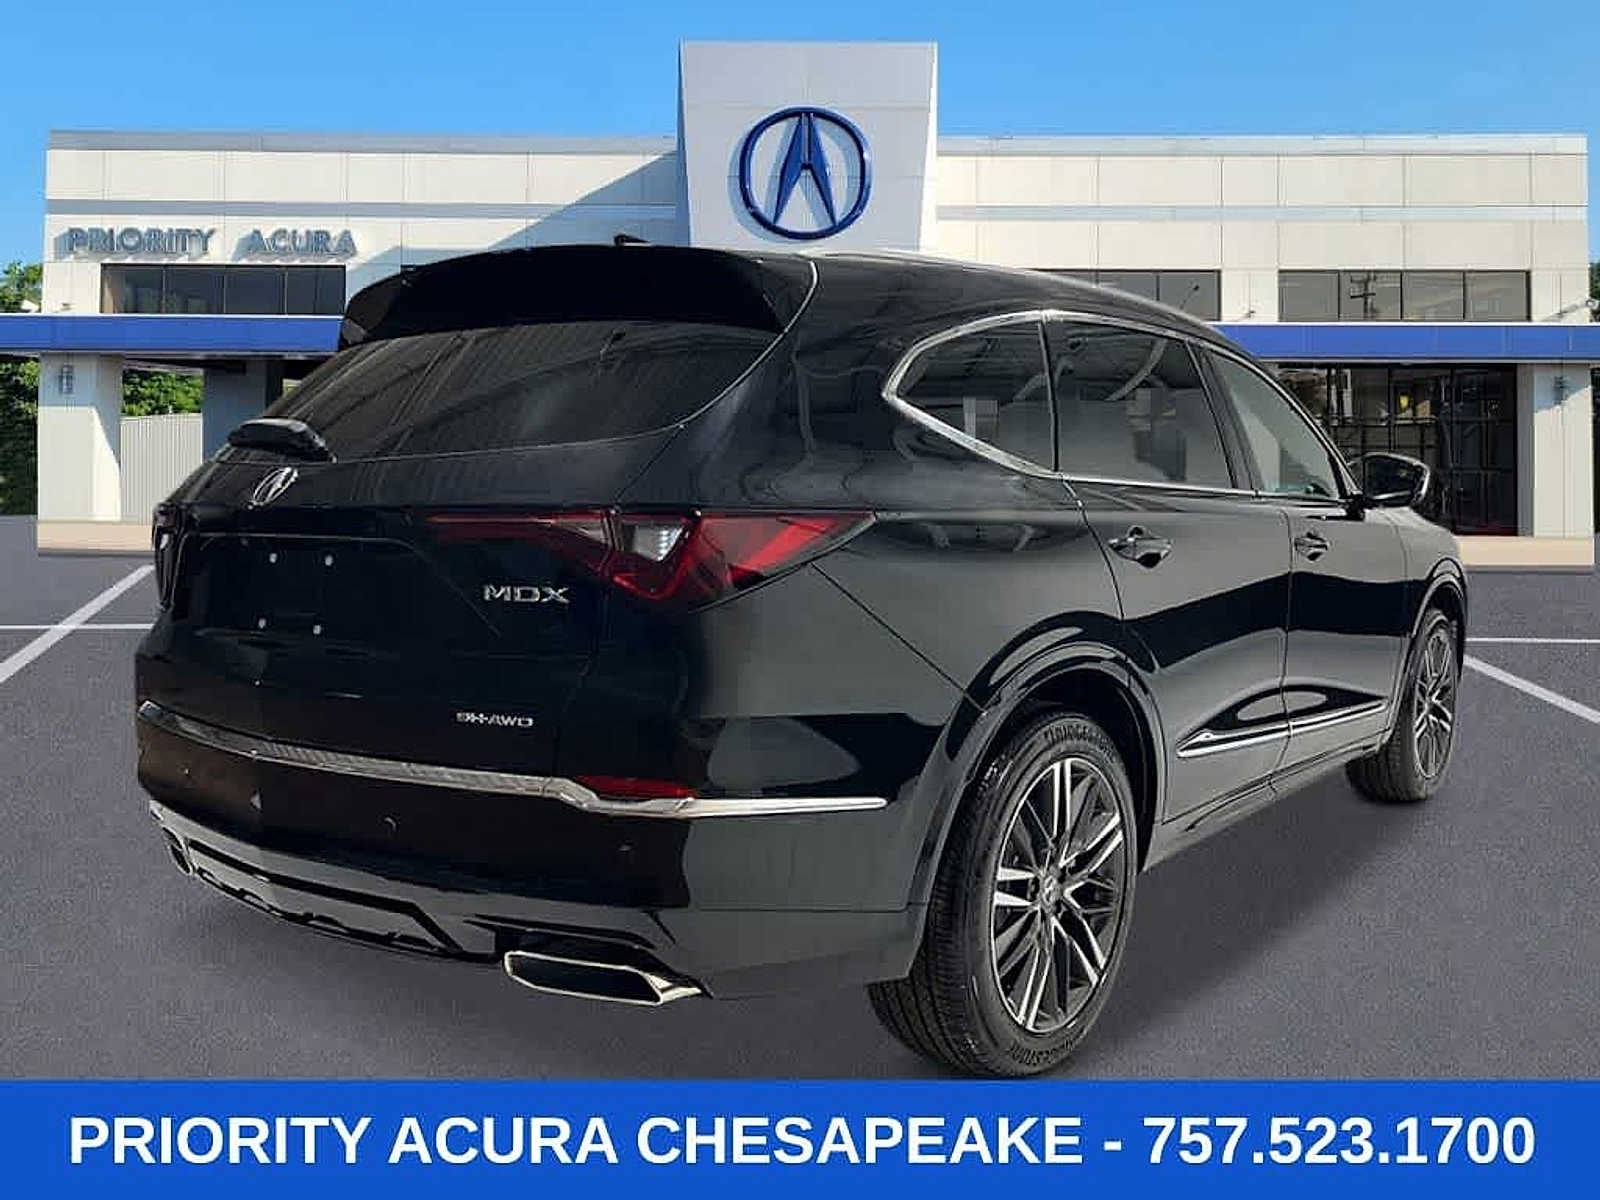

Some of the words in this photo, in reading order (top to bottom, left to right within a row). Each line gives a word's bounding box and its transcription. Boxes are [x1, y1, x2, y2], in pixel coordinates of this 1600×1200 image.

[67, 227, 215, 254] PRIORITY
[247, 228, 357, 257] ACURA
[483, 583, 570, 604] MDX
